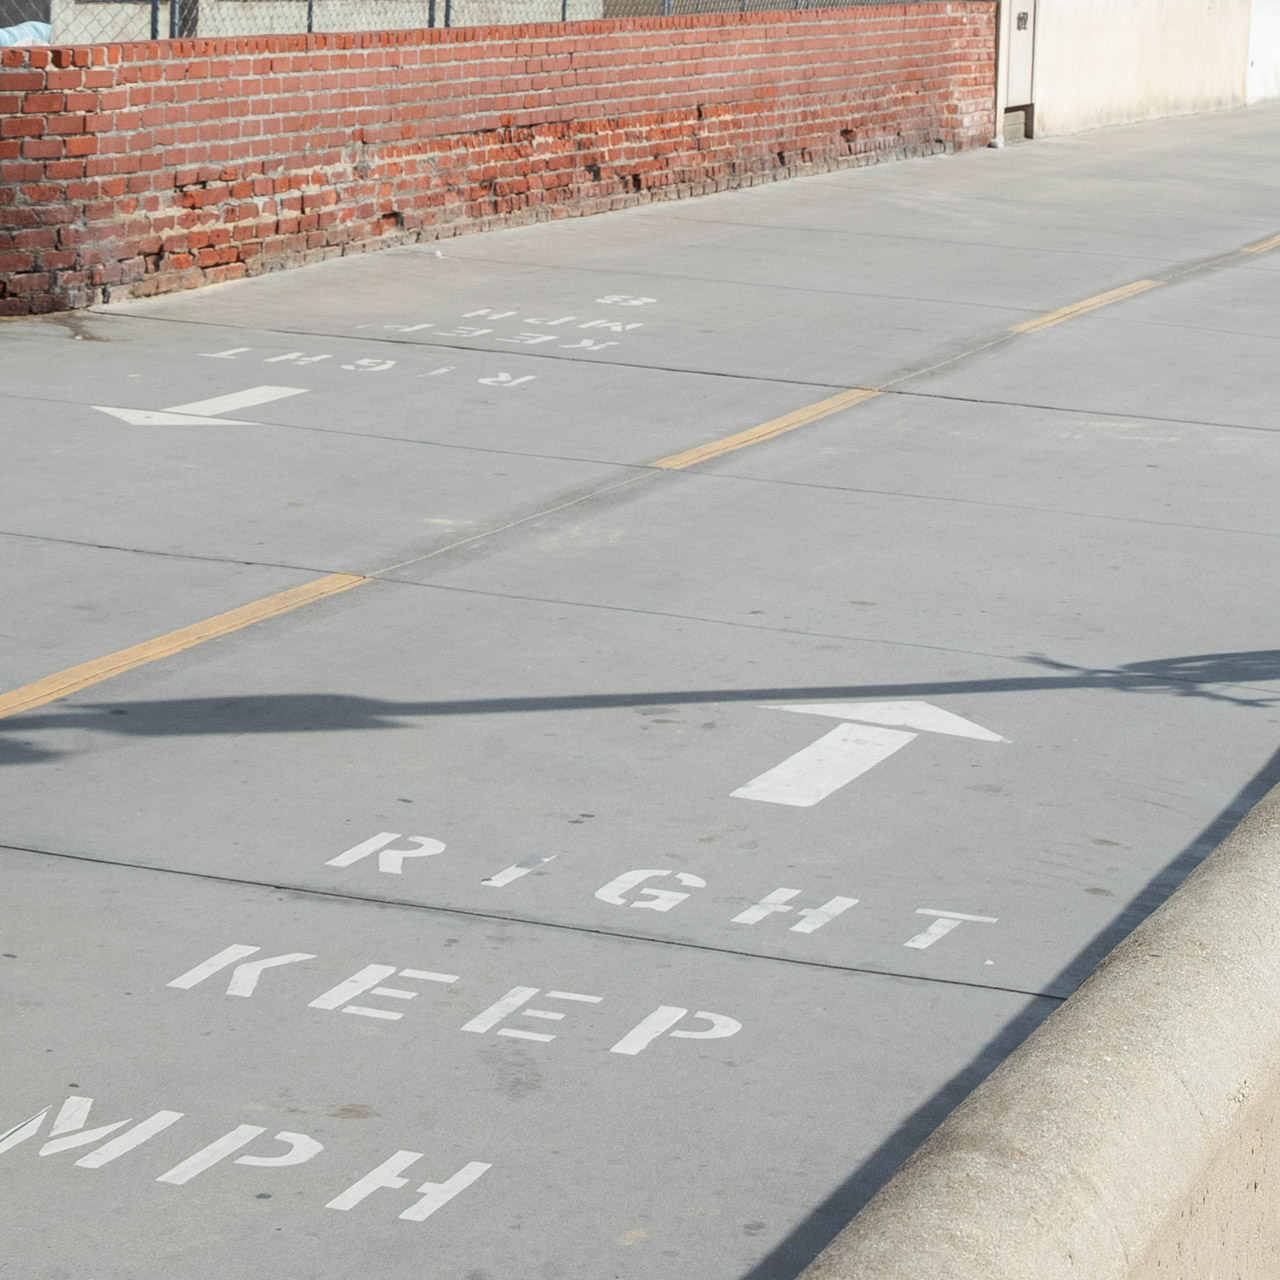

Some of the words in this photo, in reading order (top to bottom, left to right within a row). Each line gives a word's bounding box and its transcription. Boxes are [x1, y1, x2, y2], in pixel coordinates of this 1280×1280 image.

[357, 323, 619, 351] KEEP
[461, 308, 644, 332] MPH
[197, 347, 538, 388] RIGHT
[324, 832, 999, 950] RIGHT
[165, 943, 743, 1055] KEEP
